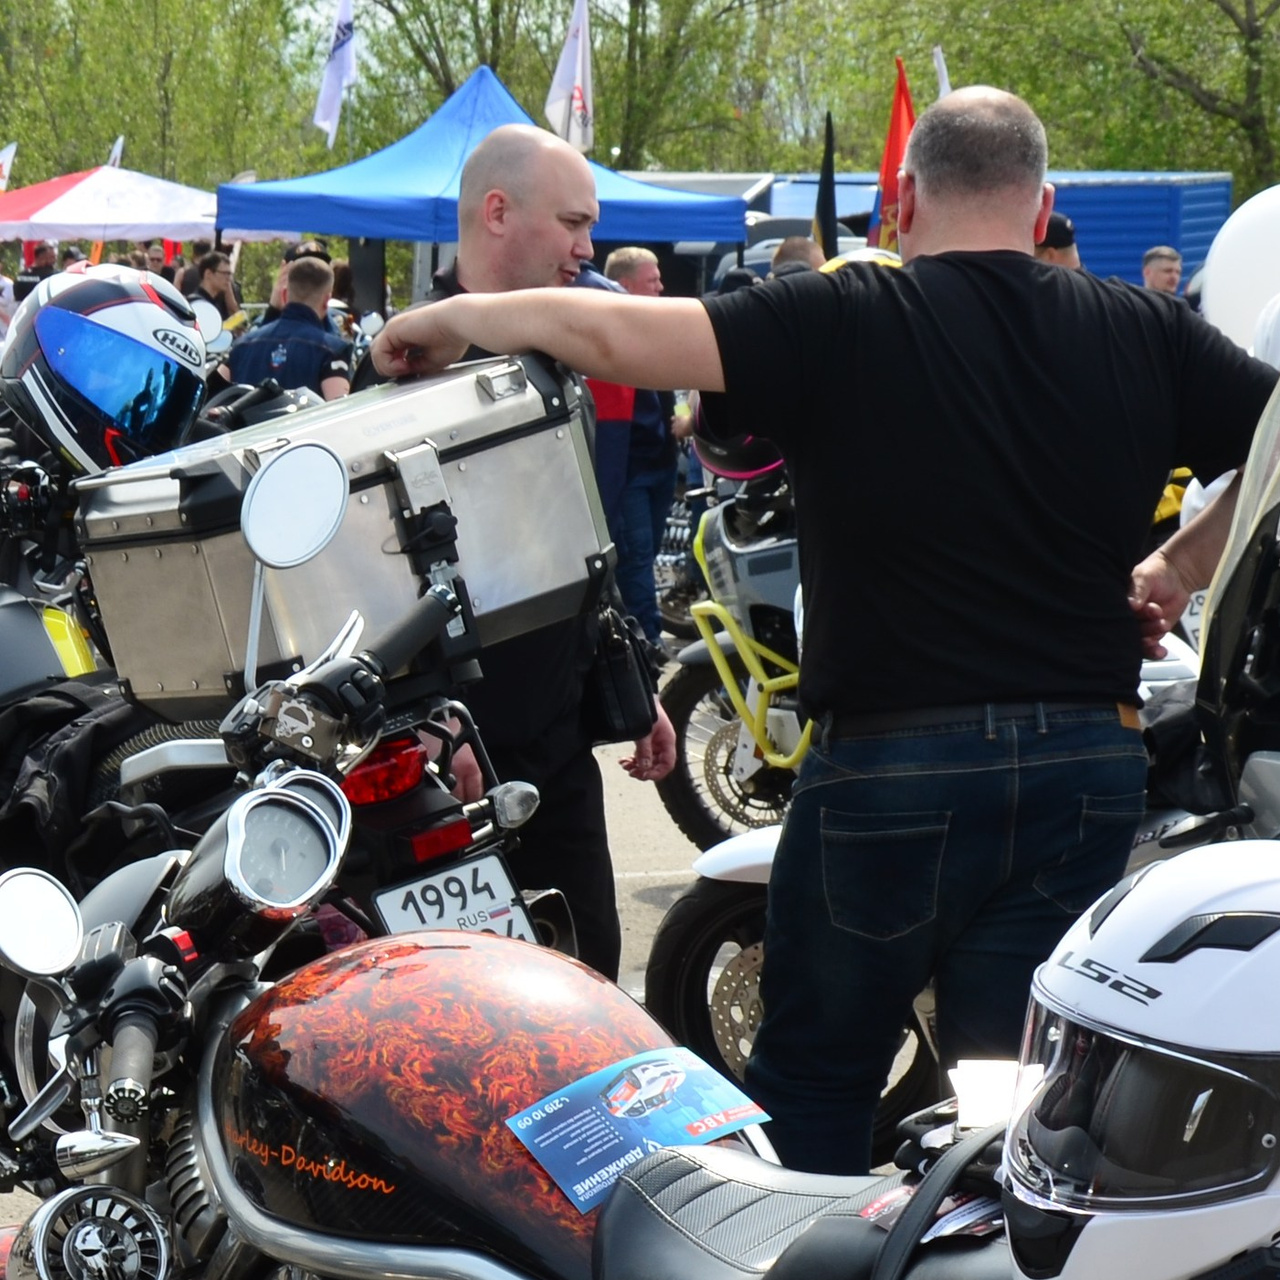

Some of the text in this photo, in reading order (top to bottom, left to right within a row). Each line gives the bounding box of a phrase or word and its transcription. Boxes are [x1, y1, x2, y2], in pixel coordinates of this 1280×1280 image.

[160, 331, 198, 362] HJC
[401, 867, 496, 925] 1994
[457, 910, 489, 931] RUS
[1057, 951, 1163, 1007] LS2
[531, 1109, 546, 1121] 10
[544, 1098, 564, 1114] 219
[517, 1115, 533, 1130] 09
[225, 1120, 395, 1194] Harley-Davidson
[572, 1144, 645, 1196] ДВИЖЕНИЕ
